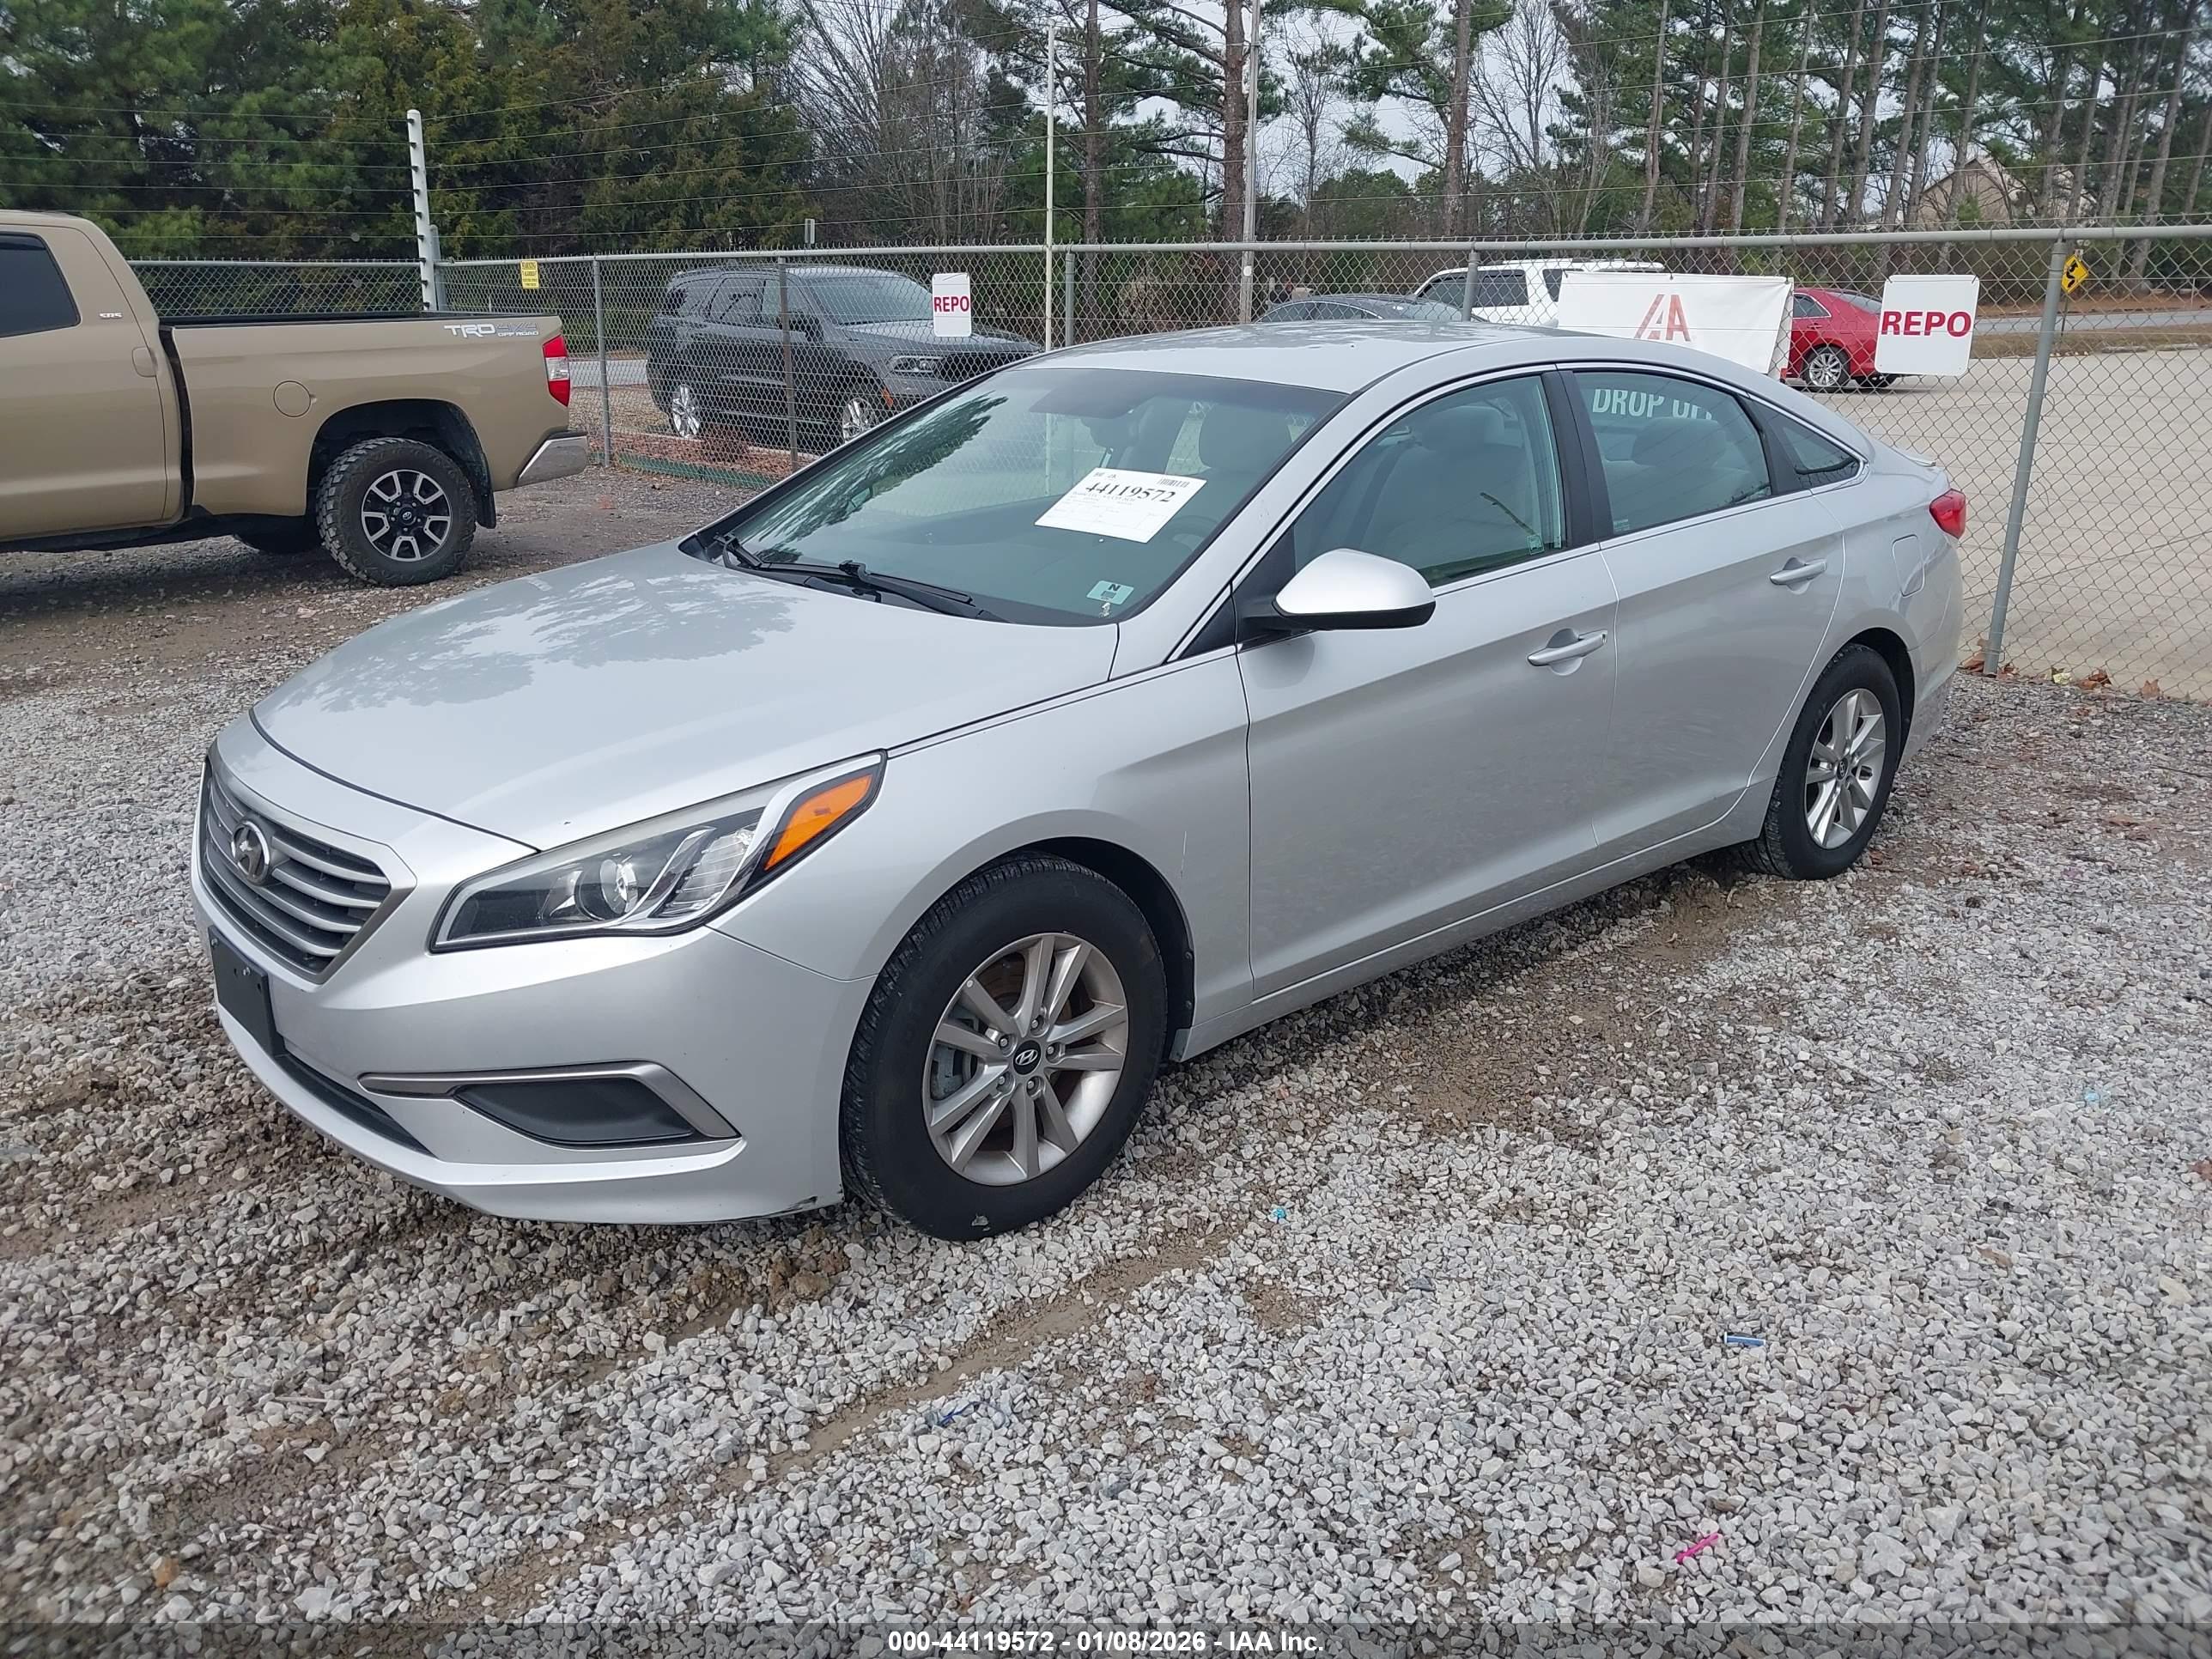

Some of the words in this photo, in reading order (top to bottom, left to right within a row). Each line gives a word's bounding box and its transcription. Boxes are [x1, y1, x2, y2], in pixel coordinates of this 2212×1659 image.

[933, 295, 969, 313] REPO
[444, 324, 495, 337] TRD
[1881, 311, 1972, 337] REPO
[1592, 388, 1665, 418] DROP
[1085, 482, 1176, 503] 44119572
